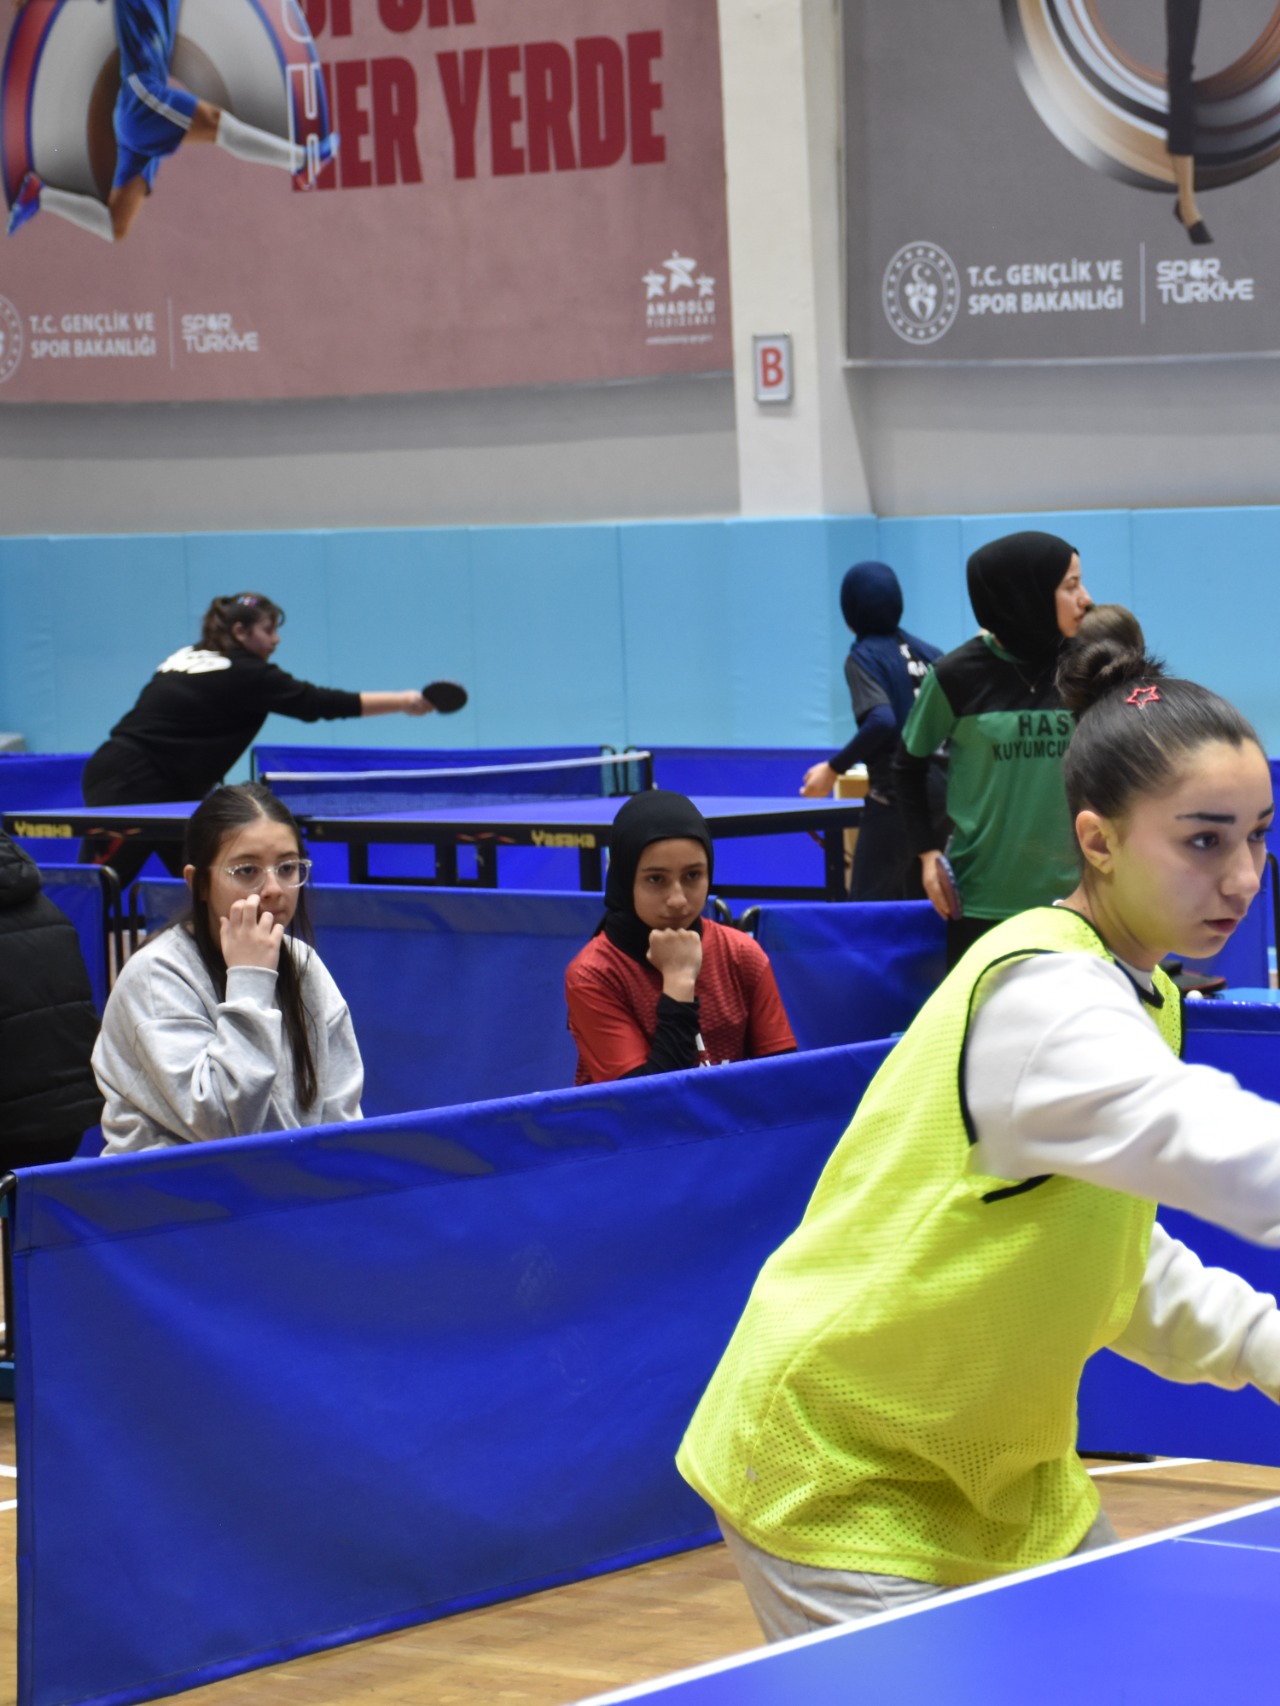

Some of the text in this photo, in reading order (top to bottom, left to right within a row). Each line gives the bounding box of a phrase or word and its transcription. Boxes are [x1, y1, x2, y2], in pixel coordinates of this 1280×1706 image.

[436, 30, 667, 181] YERDE
[967, 258, 1122, 288] T.C. GENÇLİK VE
[968, 285, 1123, 315] SPOR BAKANLIĞI
[133, 312, 155, 331] VE
[31, 339, 71, 359] SPOR
[761, 347, 784, 388] B
[1018, 713, 1070, 736] HAS
[991, 740, 1070, 761] KUYUMCU
[14, 821, 73, 838] Yasaka
[530, 829, 596, 849] Yasaka
